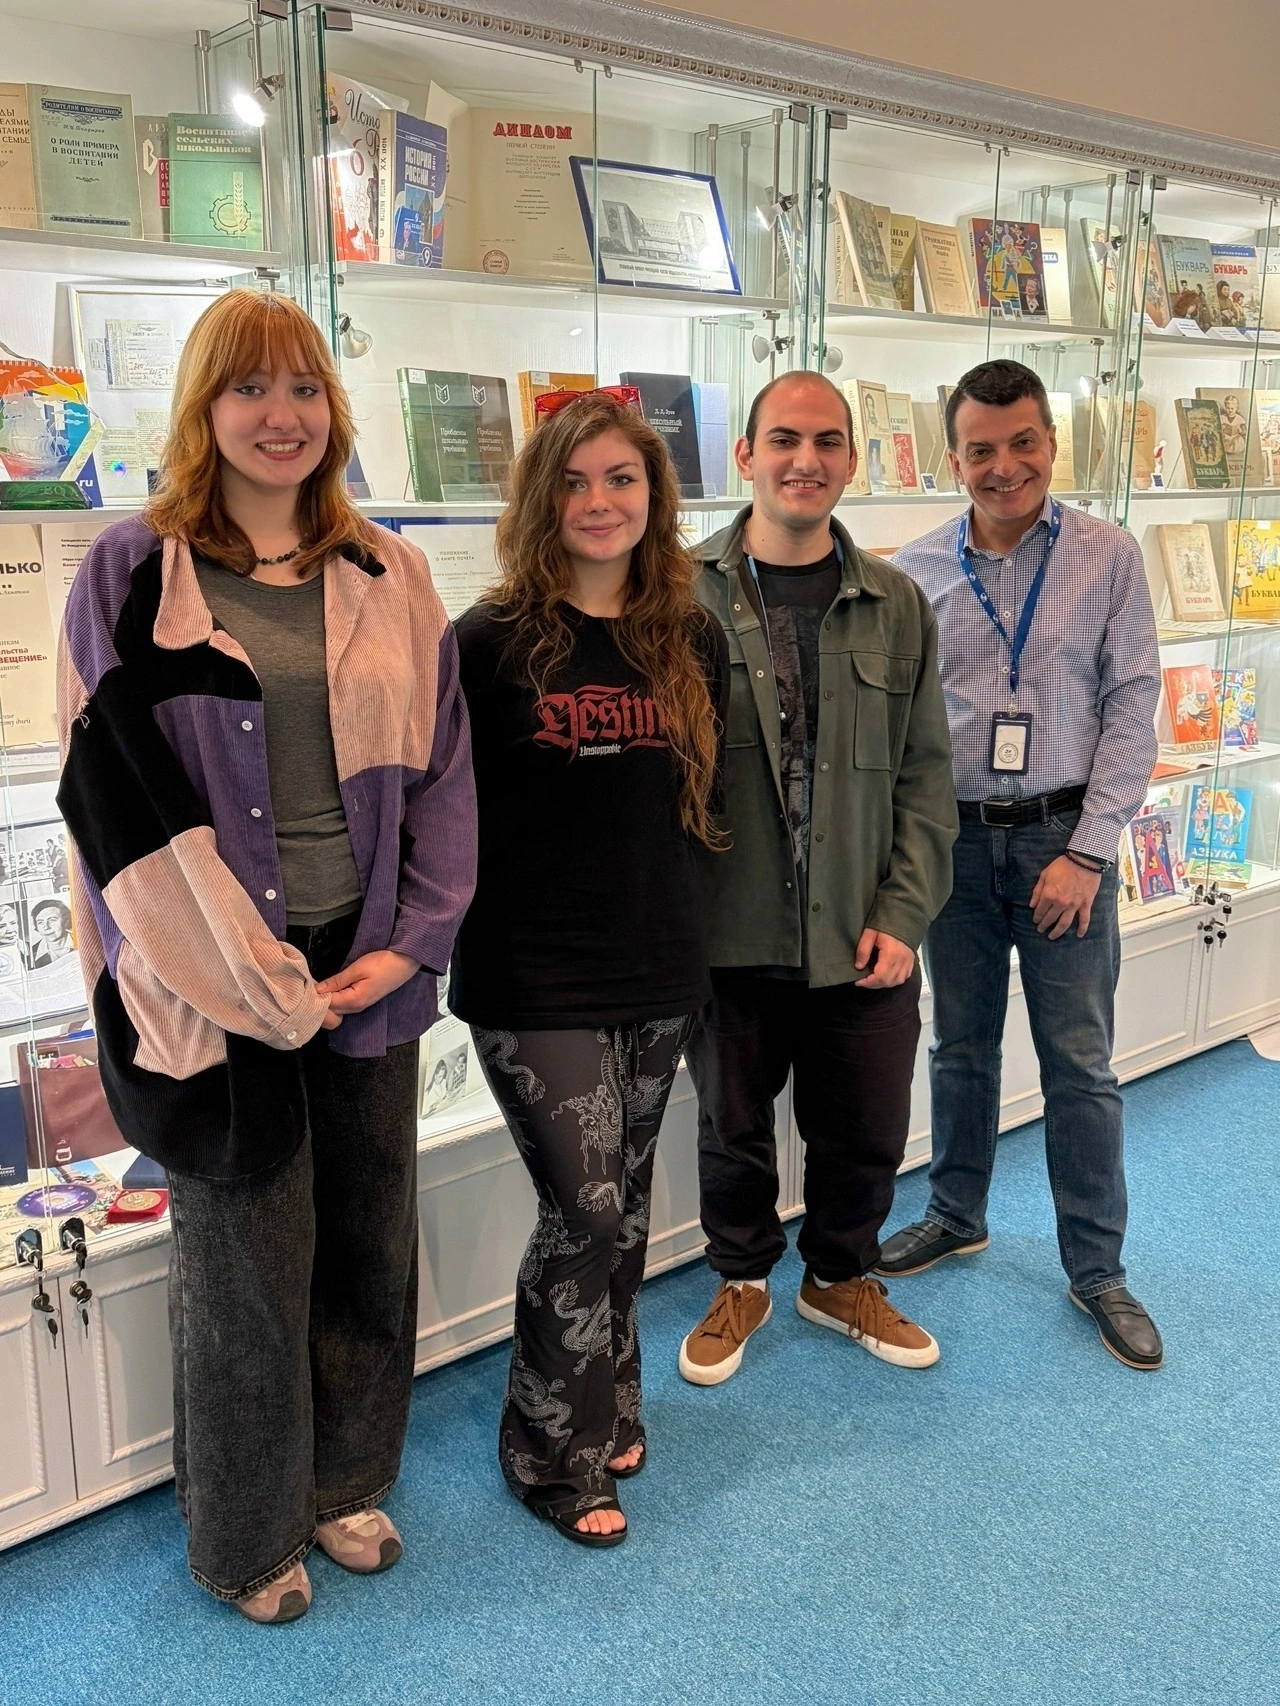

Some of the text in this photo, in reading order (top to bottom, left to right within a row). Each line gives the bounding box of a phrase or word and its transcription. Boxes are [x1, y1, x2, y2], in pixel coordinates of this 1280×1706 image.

[45, 102, 80, 110] РОДИТЕЛЯМ
[85, 106, 120, 115] ВОСПИТАНИИ
[493, 122, 572, 140] ДИПЛОМ
[2, 136, 30, 144] СЕМЬЕ
[60, 138, 80, 147] РОЛИ
[83, 140, 120, 151] ПРИМЕРА
[176, 136, 233, 144] сельских
[52, 146, 119, 160] В ВОСПИТАНИИ
[176, 144, 252, 153] школьников
[68, 158, 104, 166] ДЕТЕЙ
[405, 146, 432, 170] ИСТОРИЯ
[404, 164, 428, 186] РОССИИ
[925, 236, 956, 247] ГРАММАТИКА
[1176, 260, 1210, 273] БУКВАРЬ
[1214, 264, 1248, 275] БУКВАРЬ
[650, 418, 682, 426] ШКОЛЬНЫЙ
[440, 428, 466, 436] Проблемы
[477, 427, 502, 436] Проблемы
[443, 446, 466, 454] учебника
[1196, 468, 1224, 476] БУКВАРЬ
[579, 744, 621, 756] Unstoppable
